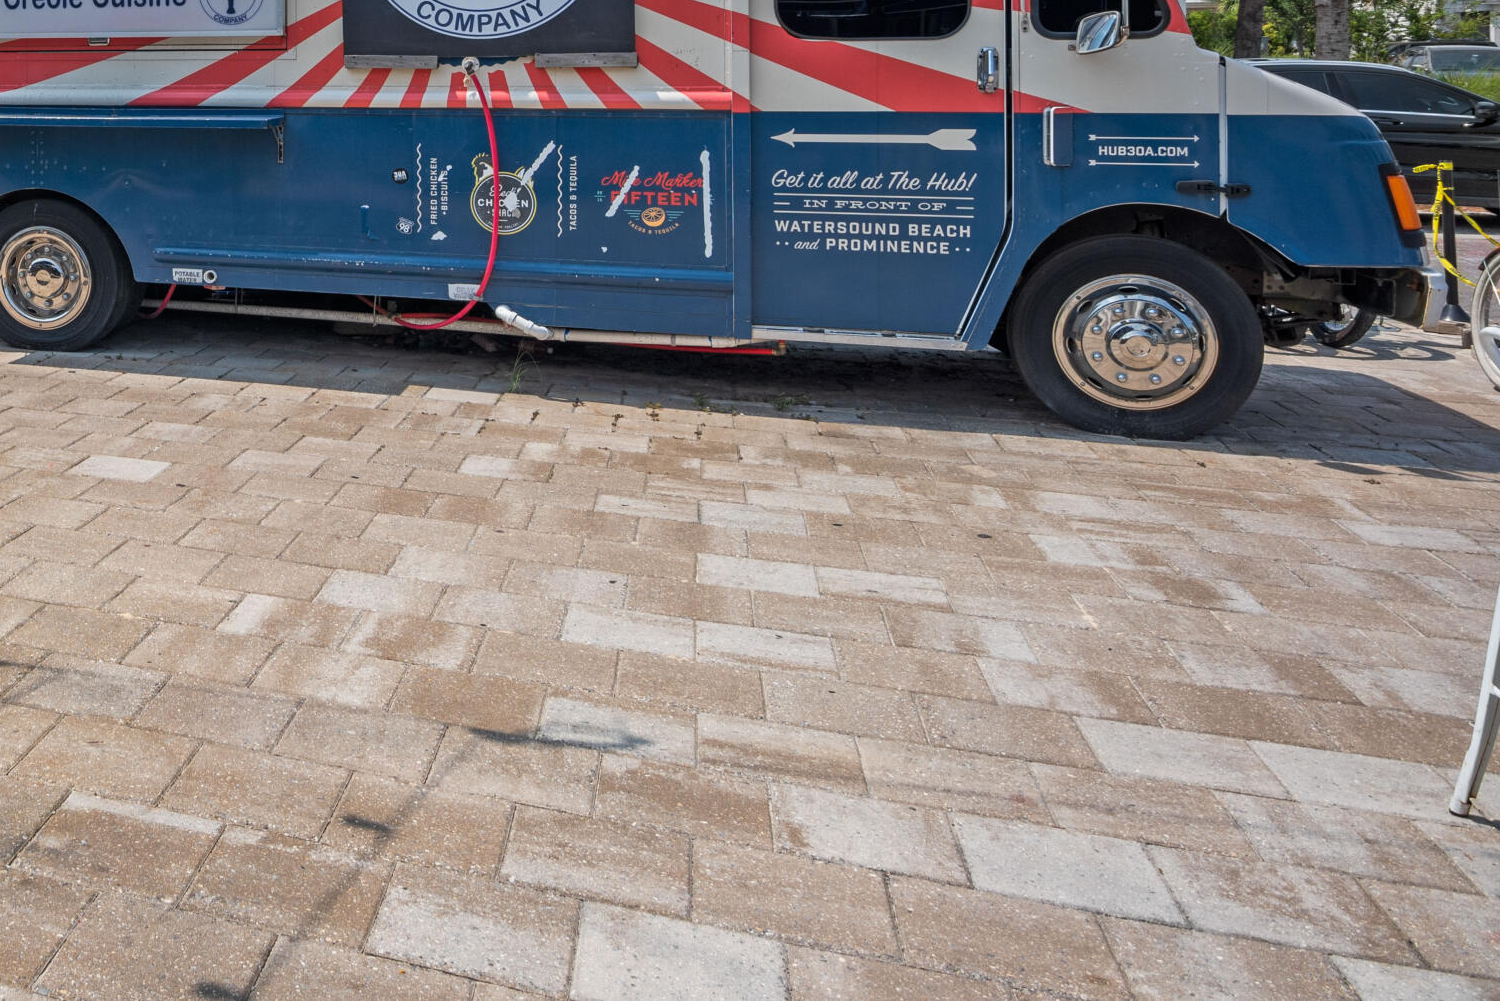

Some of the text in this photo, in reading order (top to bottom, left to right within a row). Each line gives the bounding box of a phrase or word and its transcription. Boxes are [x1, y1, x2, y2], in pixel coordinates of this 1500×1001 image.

[213, 13, 248, 24] COMPANY
[1098, 145, 1189, 157] HUB30A.COM
[569, 155, 578, 192] TEQUILA
[601, 171, 704, 190] Mie Marker
[771, 169, 978, 192] Get it all at The Hub!
[430, 157, 438, 225] FRIED CHICKEN
[477, 198, 529, 208] CHCEN
[803, 199, 947, 211] IN FRONT OF
[569, 204, 577, 231] TACOS
[627, 220, 646, 235] TACOS
[655, 222, 680, 235] TEQUILA
[775, 220, 971, 238] WATERSOUND BEACH
[794, 238, 950, 255] and PROMINENCE
